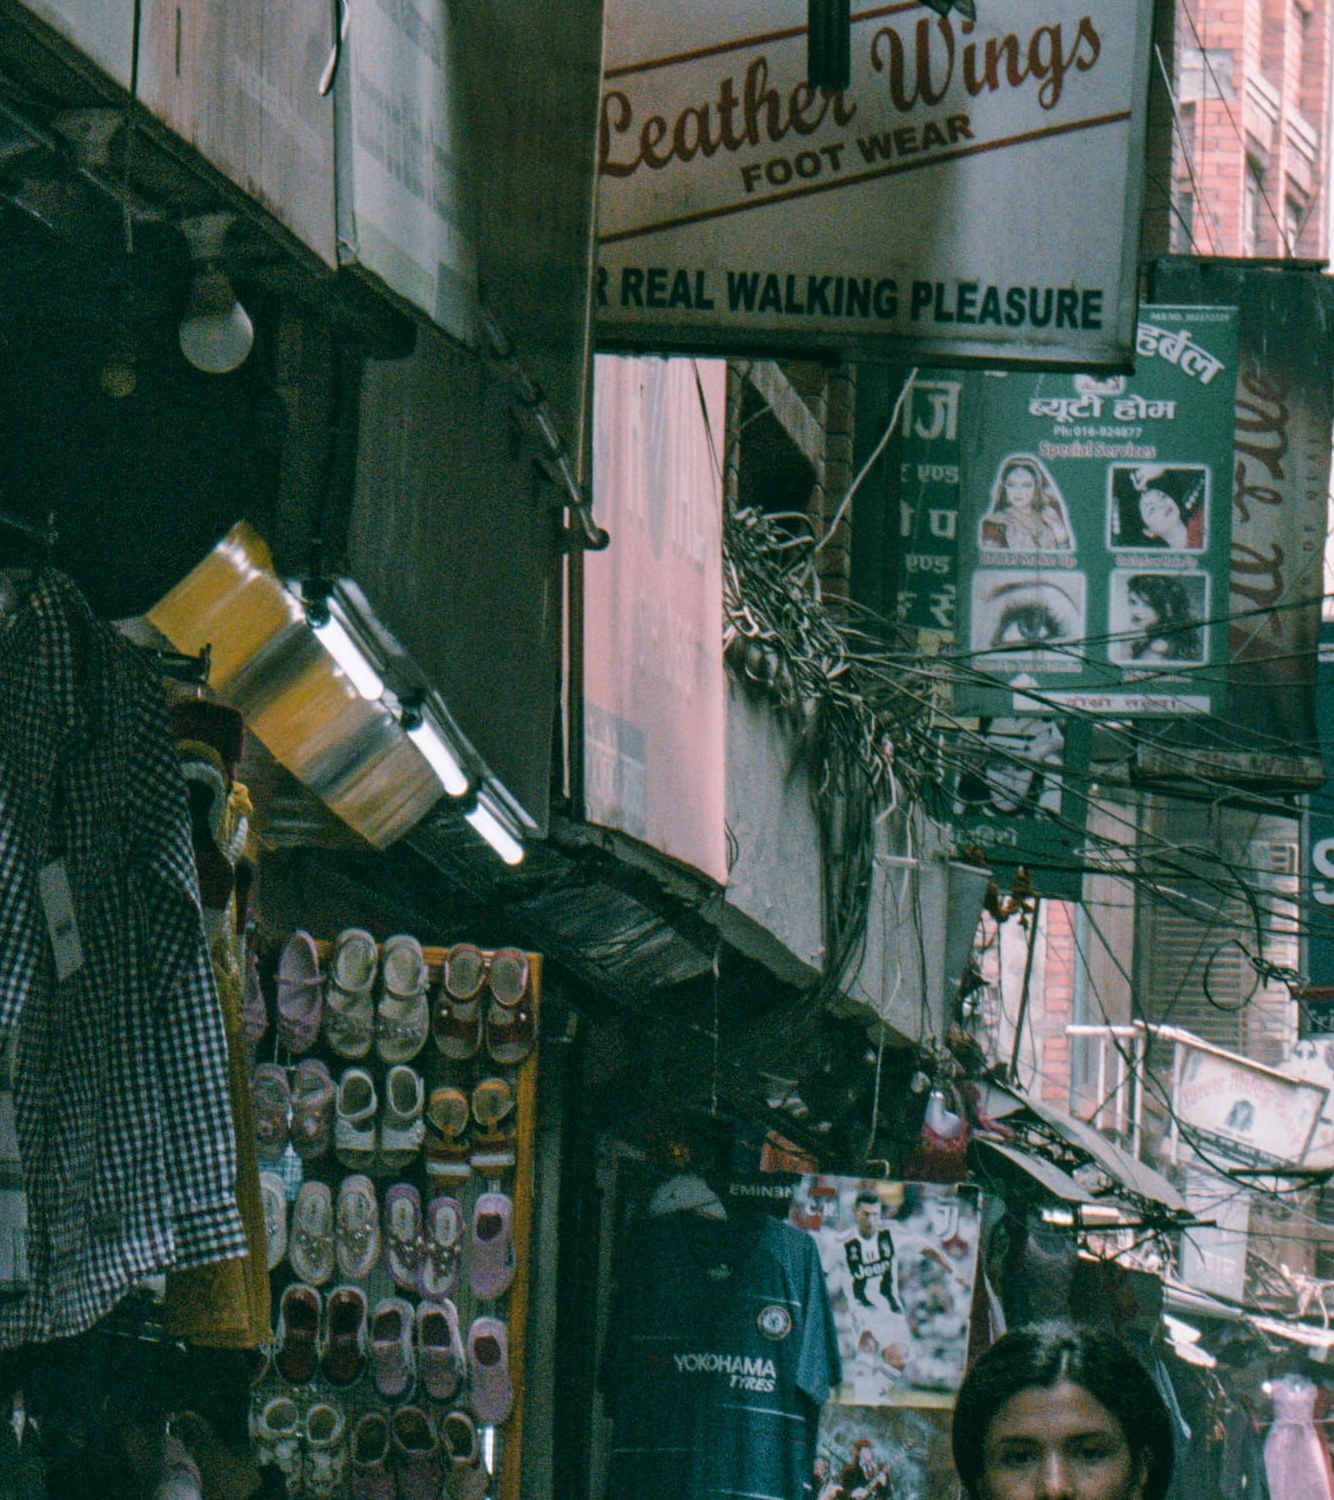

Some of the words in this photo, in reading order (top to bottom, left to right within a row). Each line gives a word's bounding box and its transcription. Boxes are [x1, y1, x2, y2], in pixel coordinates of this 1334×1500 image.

[598, 55, 857, 179] Leather
[872, 14, 1102, 112] Wings
[741, 143, 845, 194] FOOT
[857, 113, 975, 164] WEAR
[621, 267, 715, 311] REAL
[726, 271, 899, 321] WALKING
[911, 280, 1104, 332] PLEASURE
[1113, 393, 1178, 421] होम
[1039, 441, 1094, 460] Special
[1096, 441, 1158, 459] Services
[673, 1353, 777, 1379] YOKOHAMA
[729, 1373, 776, 1393] TYRES
